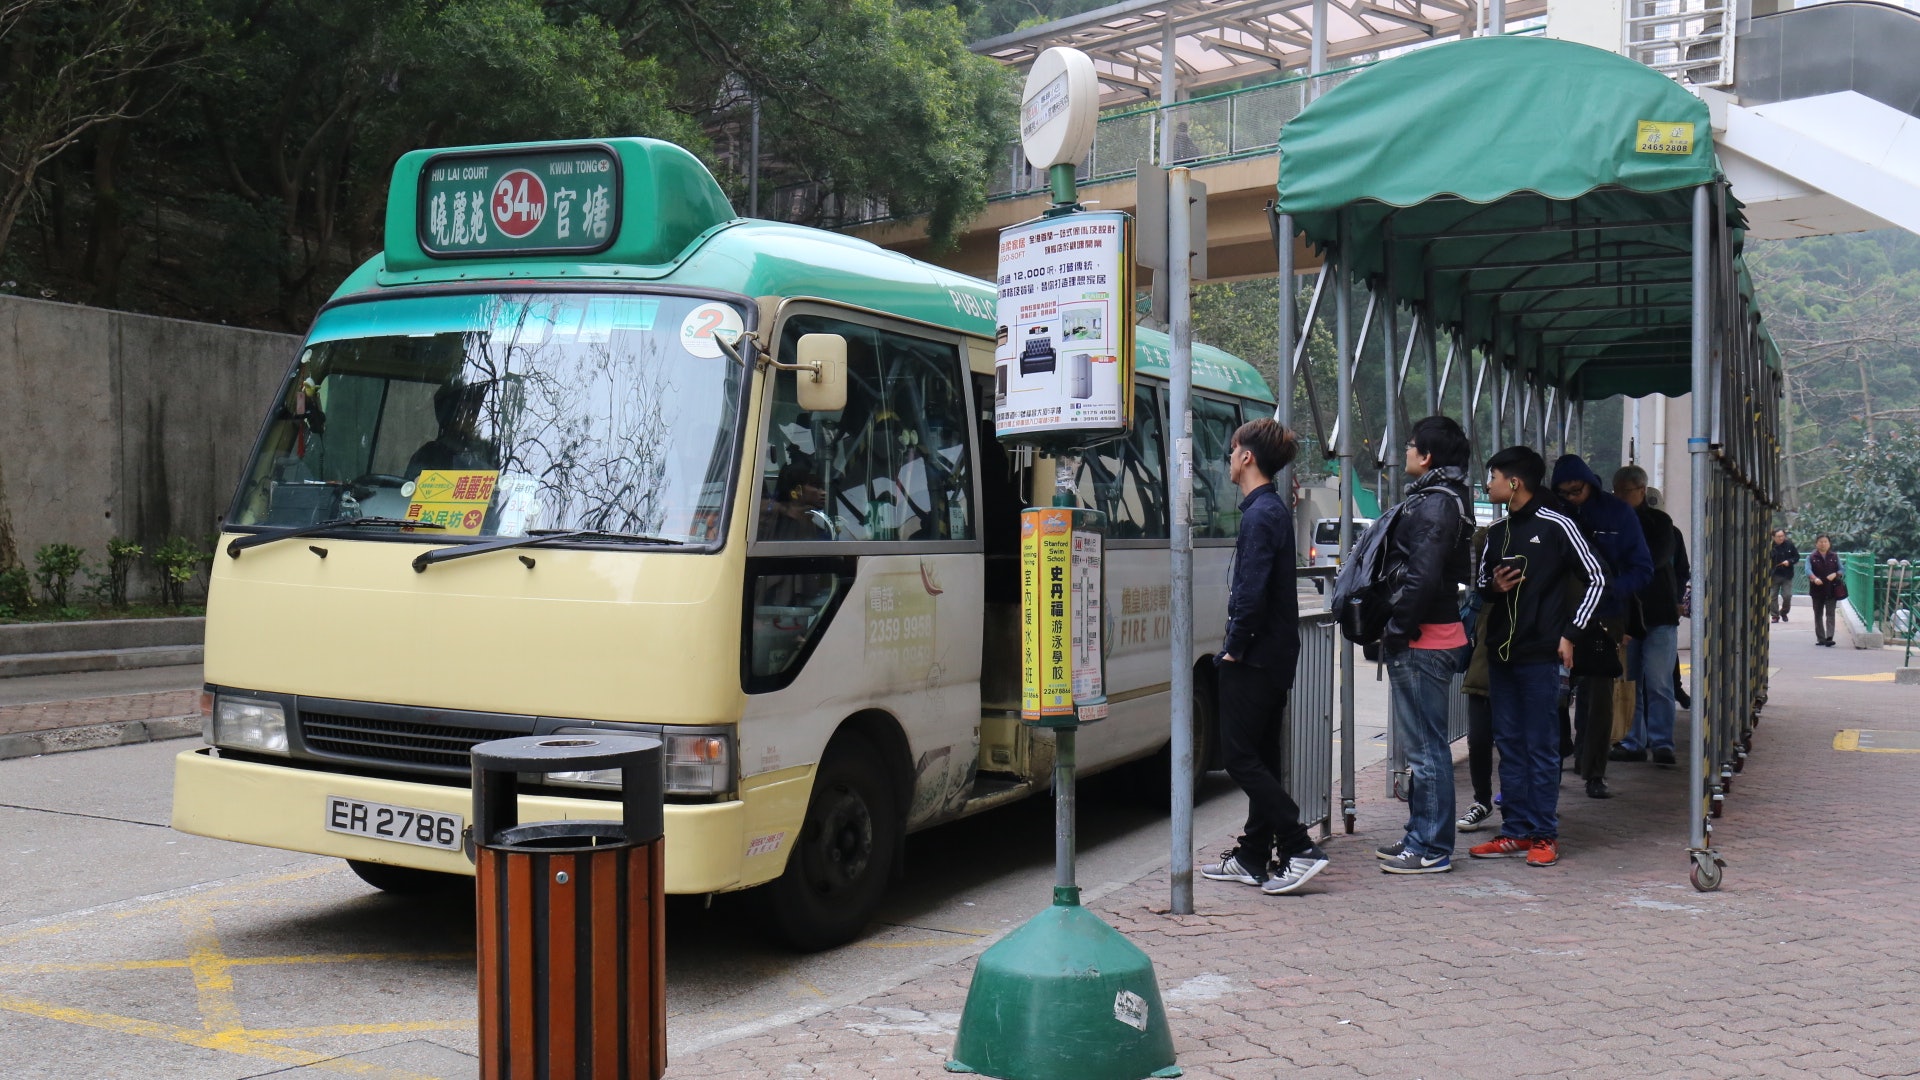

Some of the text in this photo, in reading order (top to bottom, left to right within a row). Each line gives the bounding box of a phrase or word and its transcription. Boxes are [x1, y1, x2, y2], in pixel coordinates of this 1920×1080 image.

[1642, 143, 1664, 151] 2465
[431, 166, 489, 181] HIU LAI COURT
[549, 160, 598, 175] KWUN TONG
[496, 178, 543, 223] 34M
[553, 184, 610, 240] 官塘
[430, 190, 488, 246] 曉麗苑
[1014, 267, 1046, 281] 12,000
[452, 475, 496, 500] 曉麗苑
[869, 617, 900, 644] 2359
[1050, 565, 1064, 680] 史丹福游泳學校
[1121, 616, 1171, 646] FIRE KIN
[331, 800, 455, 845] ER 2786
